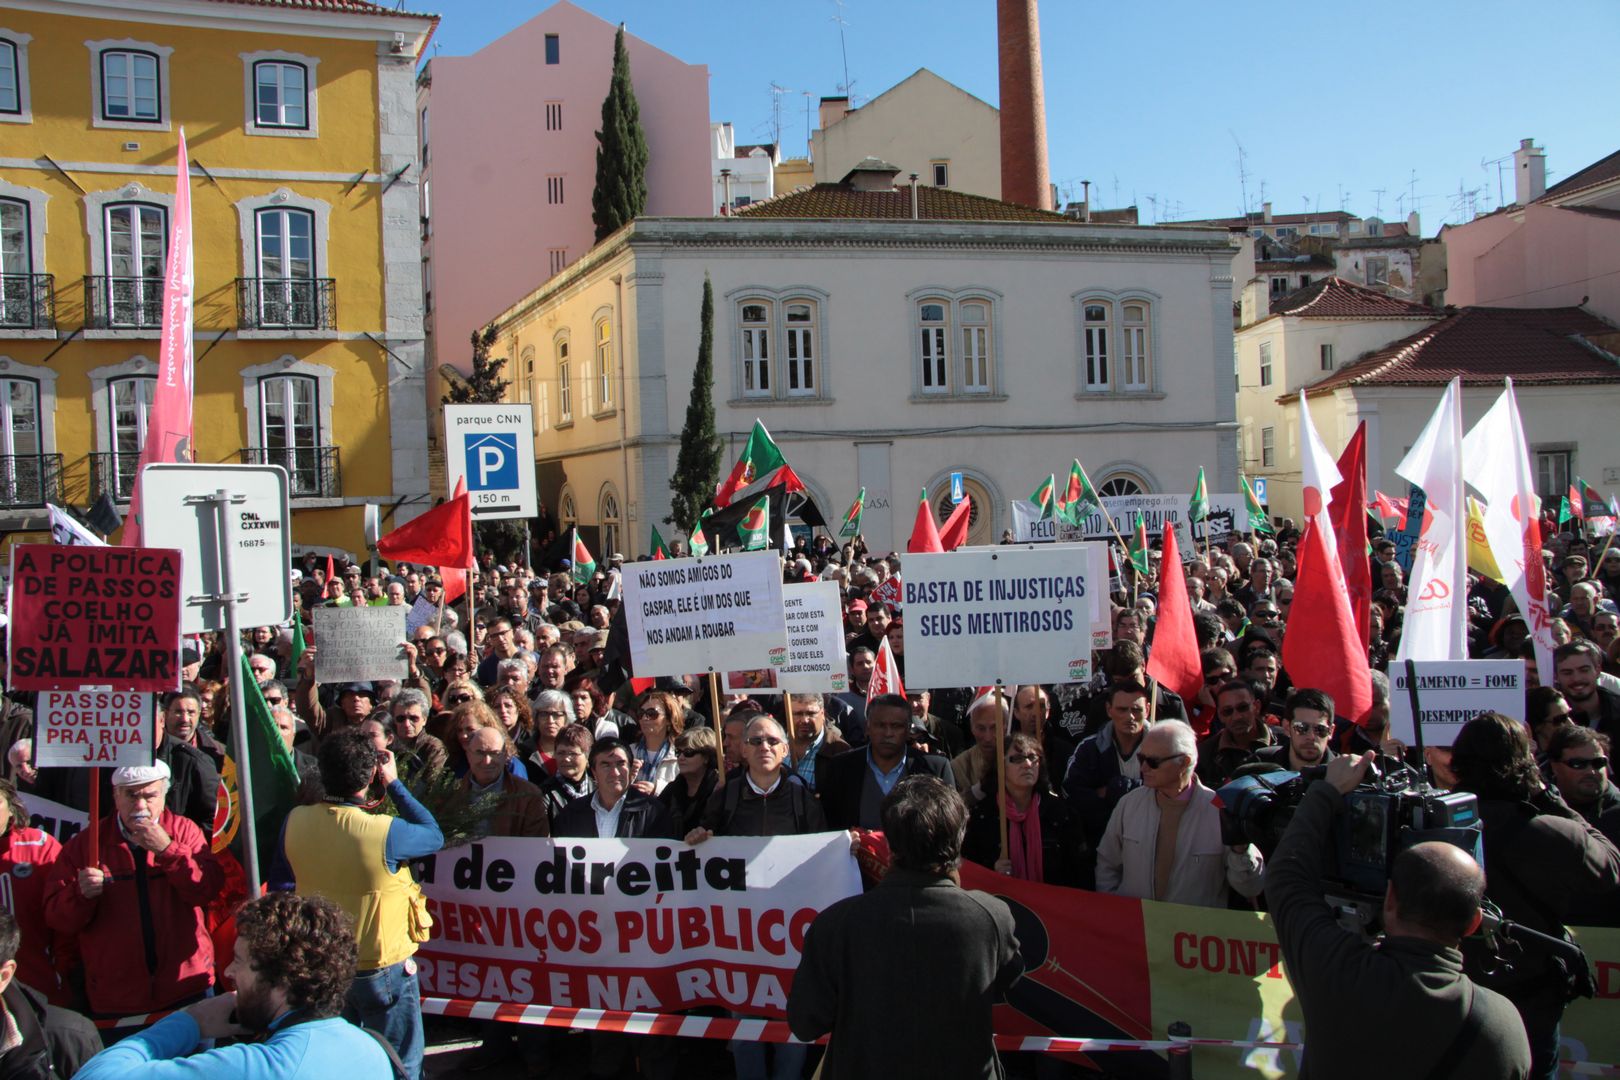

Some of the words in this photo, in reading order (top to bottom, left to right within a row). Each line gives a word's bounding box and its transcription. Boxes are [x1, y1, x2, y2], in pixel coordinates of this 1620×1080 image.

[456, 416, 493, 426] parque
[496, 414, 522, 424] CNN
[479, 446, 505, 486] P
[478, 493, 497, 503] 150
[501, 494, 510, 502] m
[240, 512, 260, 521] CML
[1030, 520, 1056, 538] PELO
[1126, 510, 1178, 532] TRBALHO
[18, 553, 37, 573] A
[51, 552, 175, 576] POLÍTICA
[639, 570, 656, 589] NÃO
[657, 568, 686, 587] SOMOS
[687, 564, 719, 584] AMIGOS
[720, 563, 733, 580] DO
[24, 576, 57, 596] DE
[68, 577, 175, 599] PASSOS
[906, 580, 959, 604] BASTA
[963, 579, 984, 602] DE
[989, 576, 1086, 604] INJUSTIÇAS
[44, 601, 154, 621] COELHO
[643, 598, 677, 617] GASPAR,
[677, 596, 692, 613] ELE
[693, 592, 700, 611] É
[700, 594, 715, 610] UM
[716, 592, 733, 609] DOS
[734, 590, 752, 607] QUE
[784, 598, 803, 608] GENTE
[796, 611, 809, 620] COM
[810, 609, 825, 619] ESTA
[920, 613, 962, 637] SEUS
[968, 609, 1073, 635] MENTIROSOS
[39, 620, 73, 643] JÁ
[88, 620, 159, 644] IMITA
[646, 629, 663, 645] NOS
[665, 626, 694, 643] ANDAM
[695, 624, 701, 640] A
[701, 621, 736, 640] ROUBAR
[801, 625, 805, 633] E
[805, 623, 819, 633] COM
[791, 637, 819, 647] GOVERNO
[14, 647, 177, 679] SALAZAR!
[796, 651, 809, 660] QUE
[809, 650, 824, 659] ELES
[802, 663, 831, 672] CONOSCO
[1396, 675, 1467, 689] OAMENTO
[1485, 674, 1518, 688] FOME
[49, 693, 142, 709] PASSOS
[48, 711, 141, 727] COELHO
[1420, 709, 1495, 723] DESEMPRE
[47, 728, 89, 744] PRA
[99, 729, 143, 744] RUA
[83, 742, 117, 761] JÁ!
[453, 843, 516, 893] de
[534, 845, 747, 896] direita
[426, 898, 602, 962] SERVIÇOS
[549, 971, 573, 1008] E
[587, 974, 663, 1012] NA
[675, 967, 789, 1011] RUA
